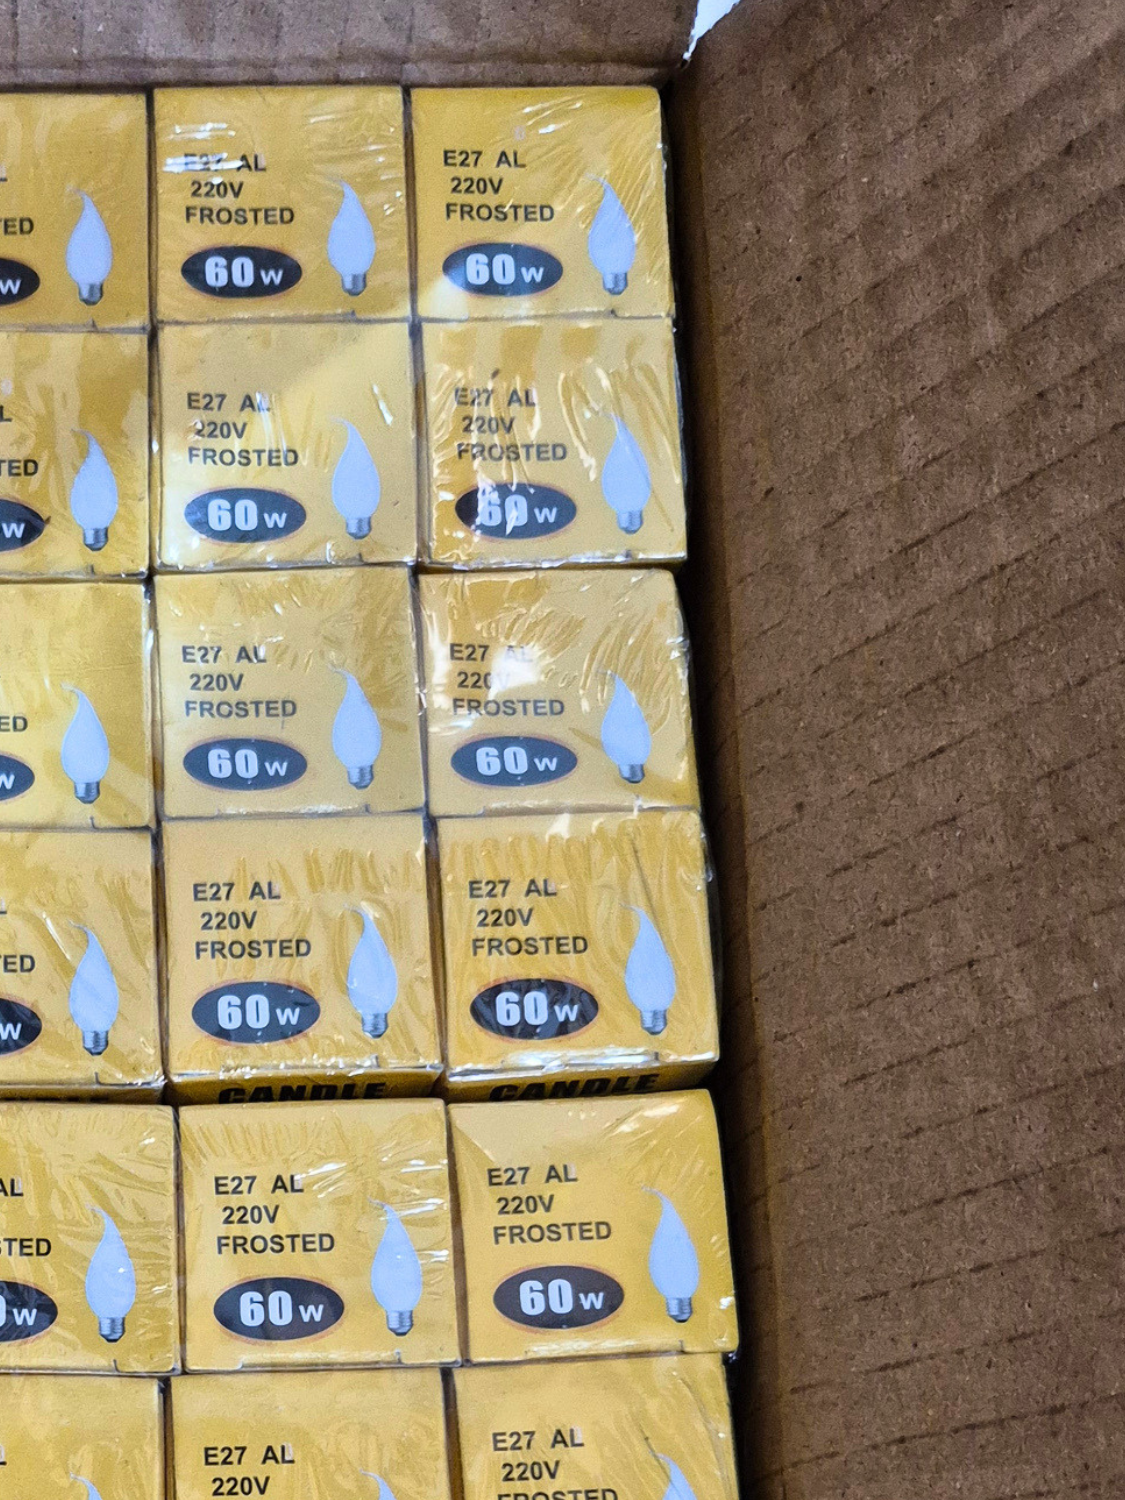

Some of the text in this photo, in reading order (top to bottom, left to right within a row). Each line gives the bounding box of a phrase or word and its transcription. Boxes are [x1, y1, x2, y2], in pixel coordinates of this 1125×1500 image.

[444, 150, 525, 167] E27 AL
[451, 177, 502, 194] 220V
[446, 203, 554, 221] FROSTED
[182, 645, 267, 663] E27 AL
[190, 673, 244, 691] 220V
[186, 700, 297, 718] FROSTED
[193, 881, 280, 901] E27 AL
[469, 879, 557, 898] E27 AL
[202, 911, 257, 930] 220V
[478, 908, 533, 927] 220V
[196, 938, 311, 959] FROSTED
[472, 936, 588, 956] FROSTED
[218, 1082, 386, 1104] CANDLE
[489, 1073, 659, 1101] CANDLE
[488, 1165, 577, 1186] E27 AL
[497, 1195, 554, 1214] 220V
[494, 1221, 611, 1244] FROSTED
[493, 1429, 584, 1451] E27 AL
[204, 1445, 295, 1466] E27 AL
[502, 1460, 560, 1482] 220V
[212, 1476, 270, 1496] 220V
